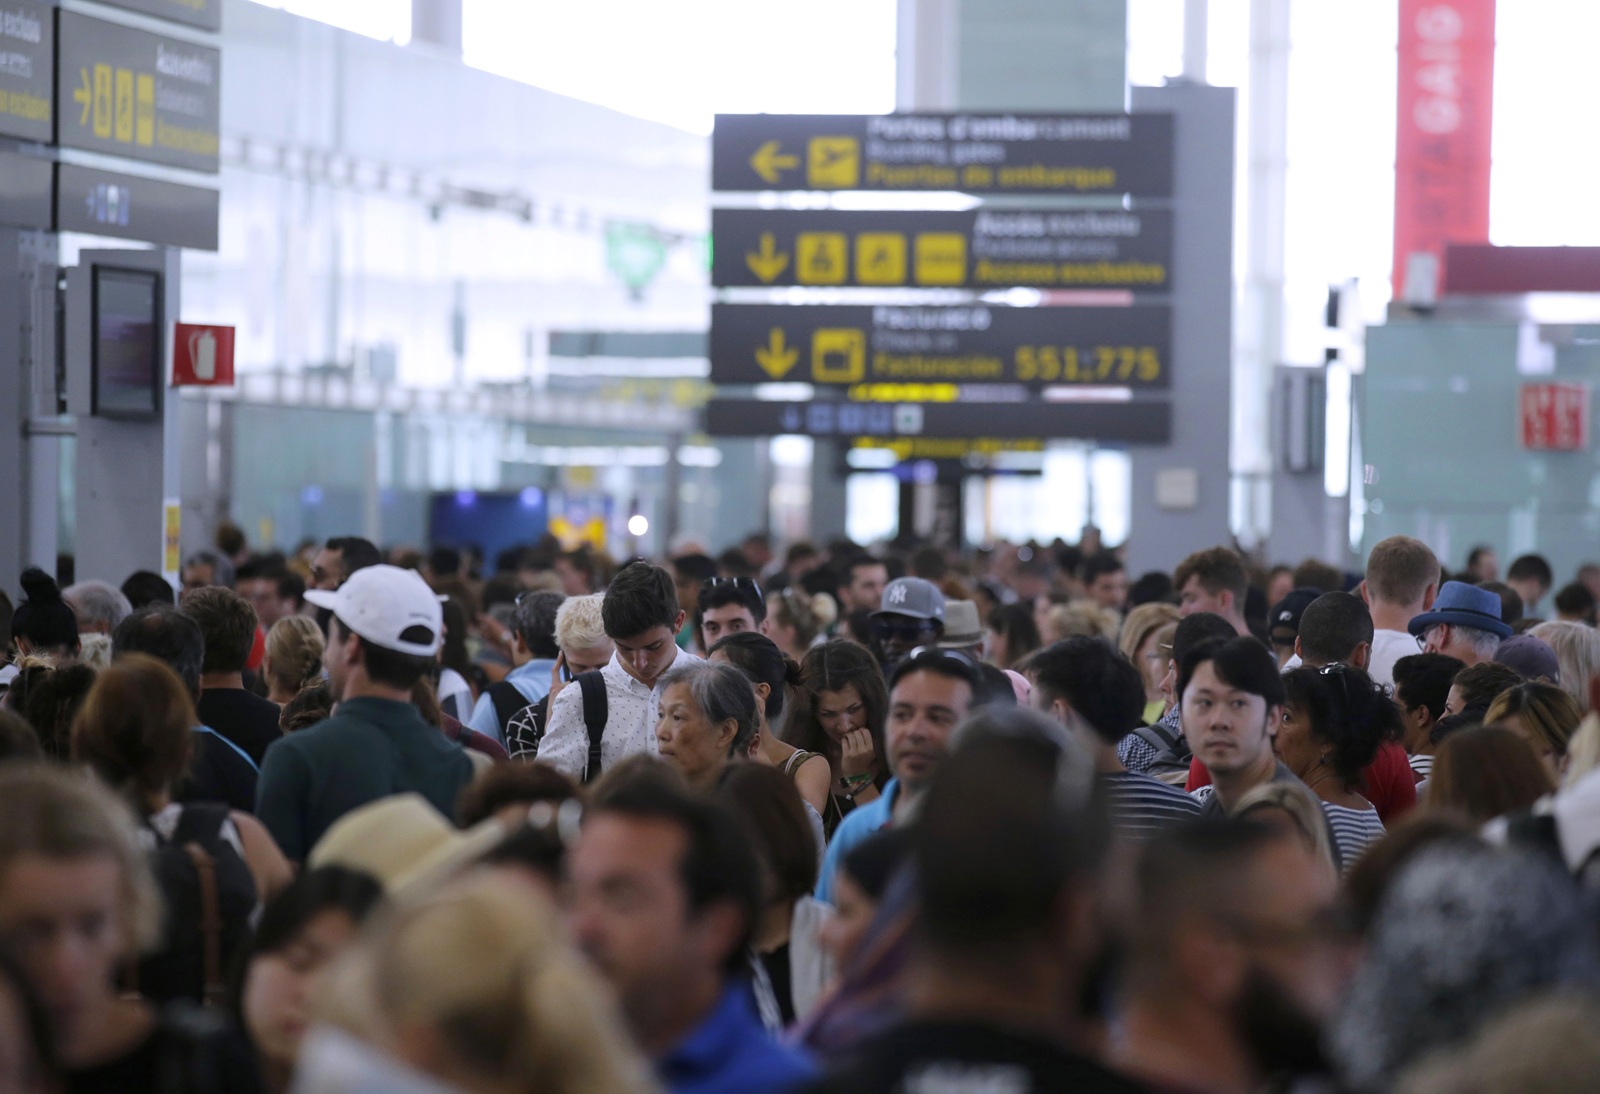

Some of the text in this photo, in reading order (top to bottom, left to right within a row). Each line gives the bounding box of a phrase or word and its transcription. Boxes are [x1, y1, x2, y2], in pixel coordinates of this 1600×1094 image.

[866, 163, 1115, 188] Puertas de embarque
